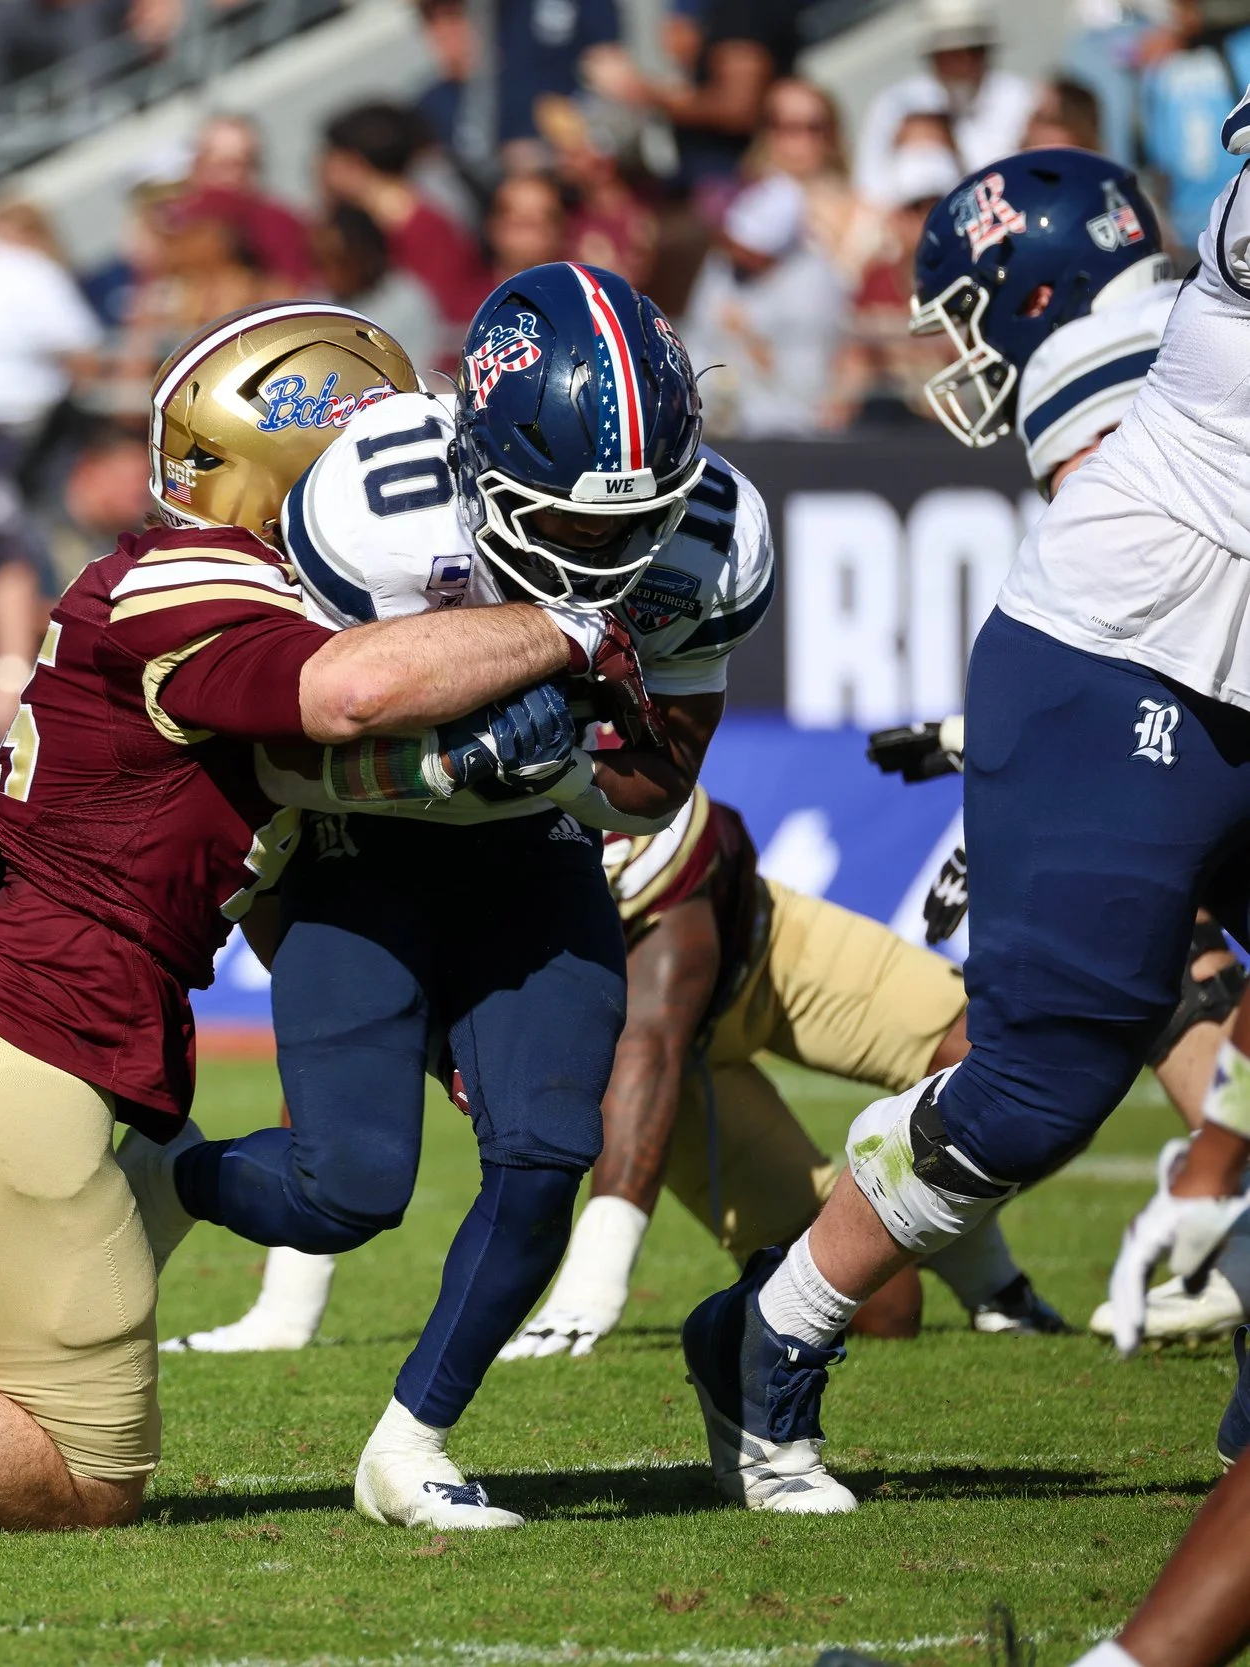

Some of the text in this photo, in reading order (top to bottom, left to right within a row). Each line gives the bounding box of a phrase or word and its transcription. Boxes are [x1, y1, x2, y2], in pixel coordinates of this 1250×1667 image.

[257, 373, 399, 433] Bobc
[166, 460, 197, 488] SBC
[356, 413, 457, 520] 10
[605, 478, 635, 494] WE
[428, 555, 471, 589] C
[636, 601, 666, 614] BOWL
[653, 592, 696, 612] FORCES
[783, 488, 1053, 730] RO
[1090, 615, 1124, 633] AEROREADY
[1132, 699, 1180, 766] R
